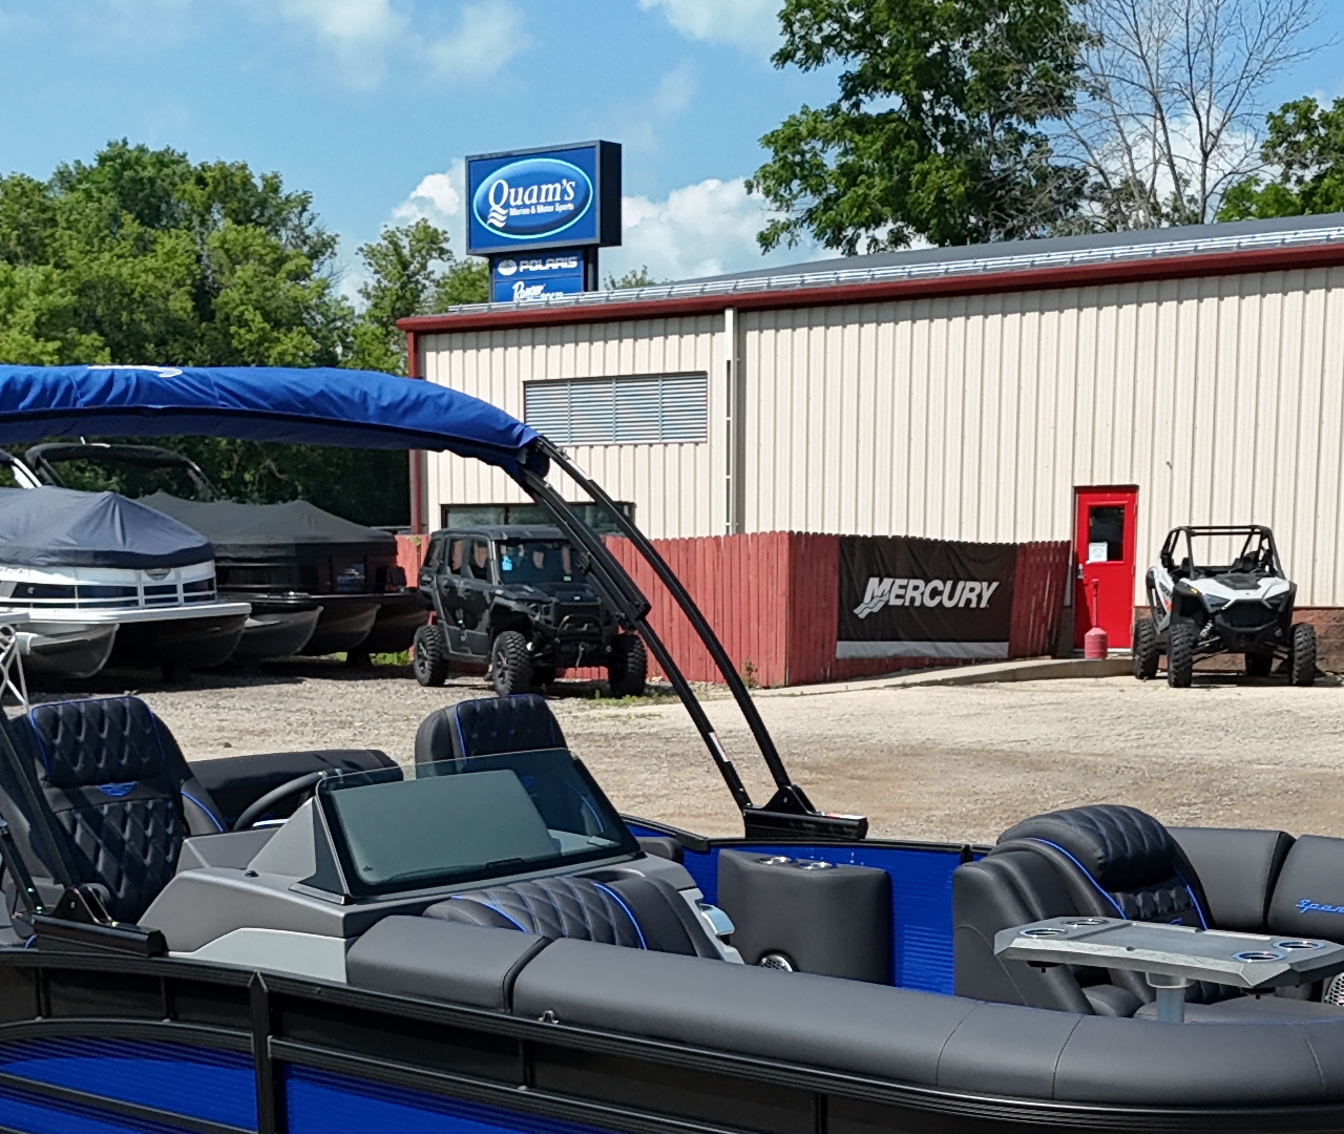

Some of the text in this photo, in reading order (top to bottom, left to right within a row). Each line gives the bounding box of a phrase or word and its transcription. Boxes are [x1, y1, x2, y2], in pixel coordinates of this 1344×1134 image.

[488, 178, 576, 215] Quam's
[537, 204, 554, 214] Motor
[519, 256, 578, 272] POLARIS
[854, 577, 999, 616] MERCURY
